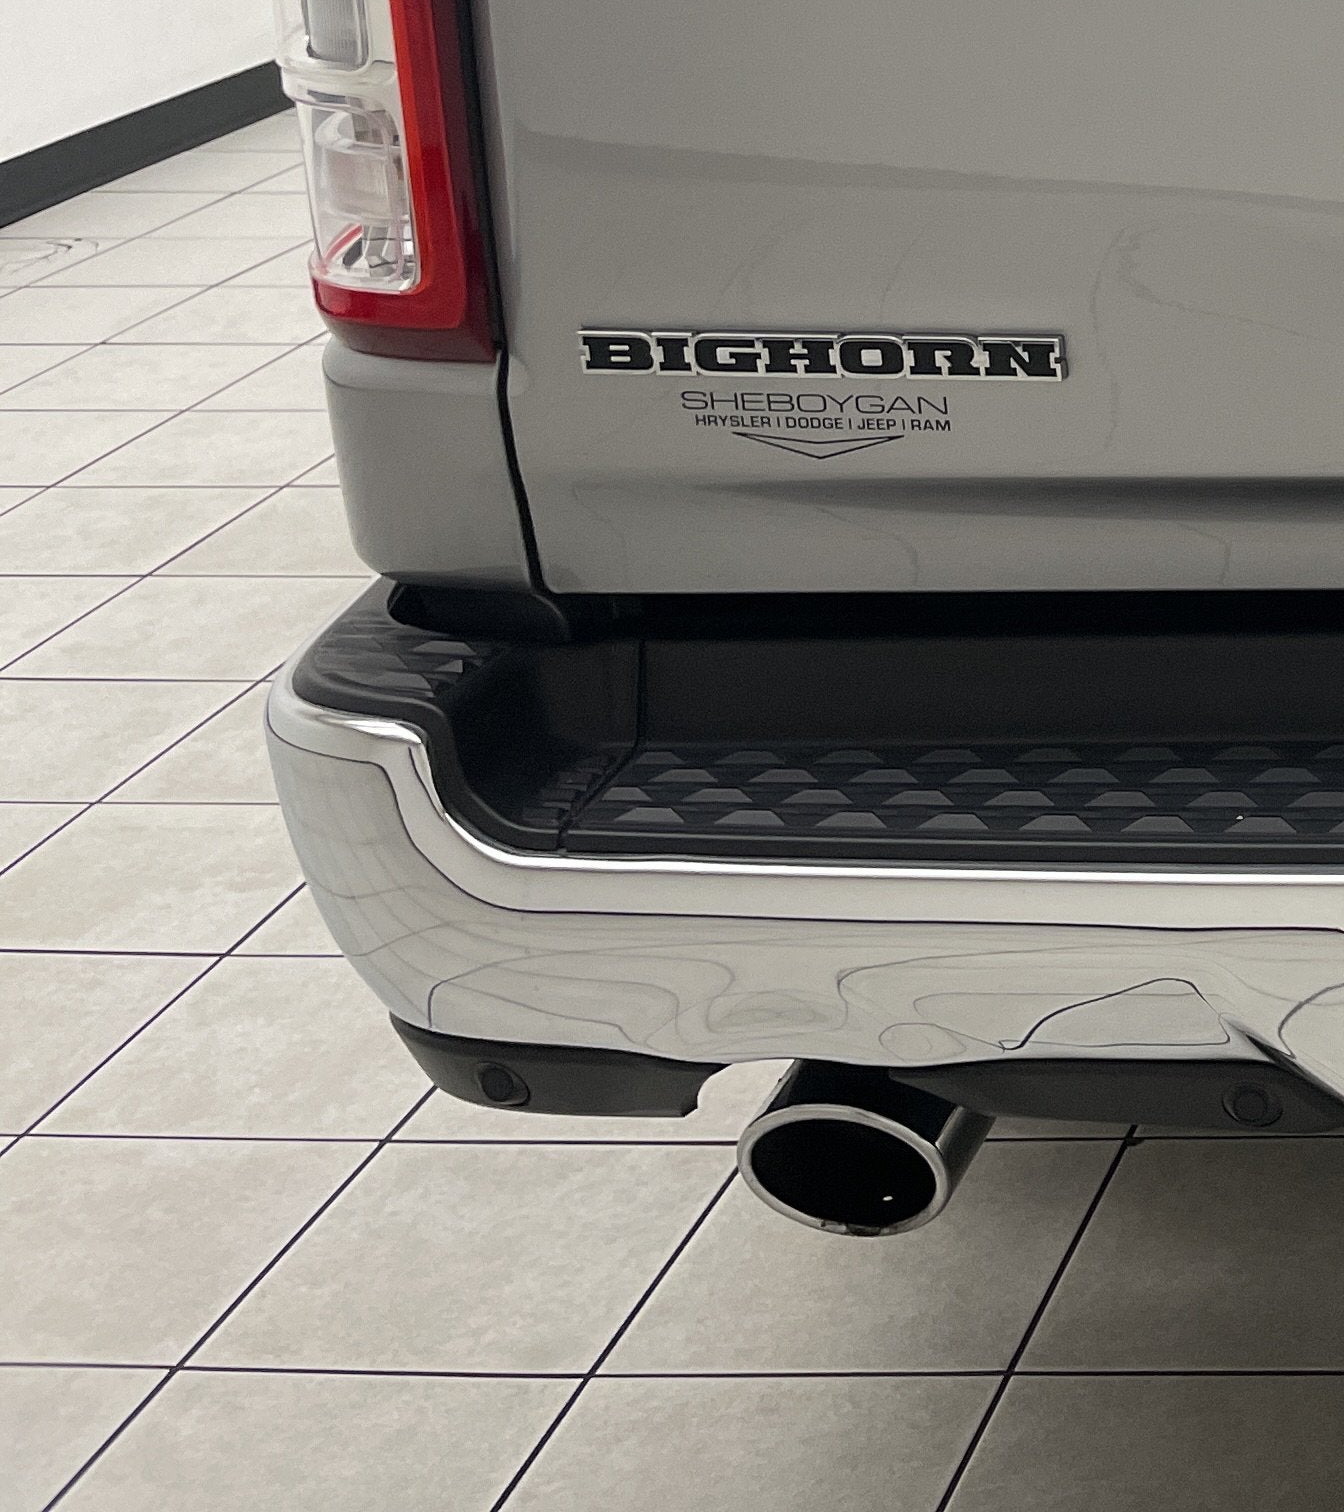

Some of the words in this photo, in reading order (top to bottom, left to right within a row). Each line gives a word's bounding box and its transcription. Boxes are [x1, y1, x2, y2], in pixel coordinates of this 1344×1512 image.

[578, 330, 1068, 381] BIGHORN
[680, 390, 949, 415] SHEBOYGAN
[694, 413, 772, 428] HRYSLER
[785, 416, 844, 429] DODGE
[856, 417, 897, 431] JEEP
[910, 418, 951, 432] RAM
